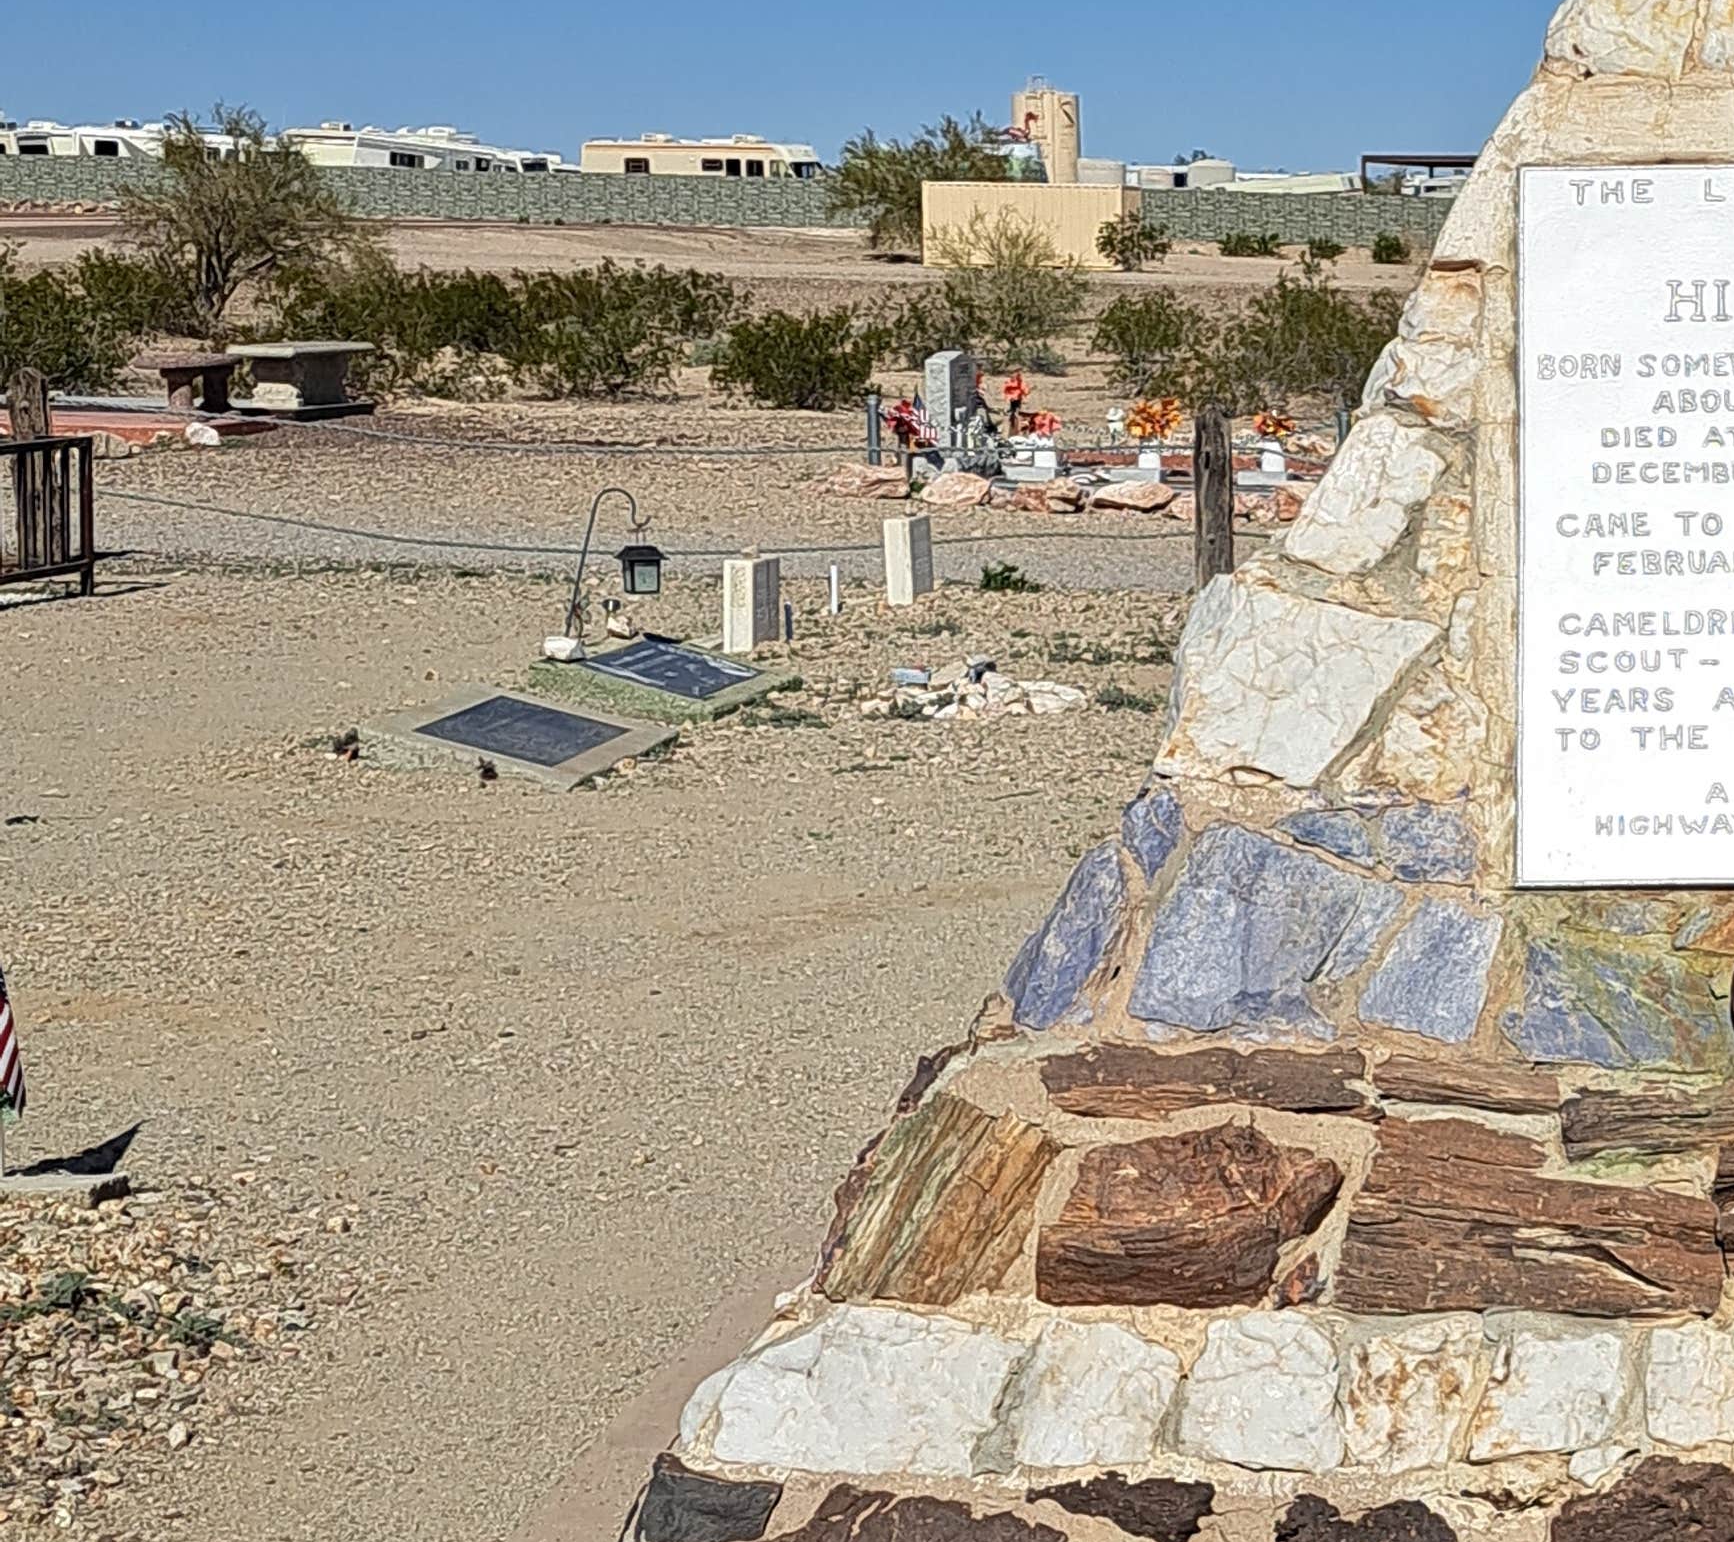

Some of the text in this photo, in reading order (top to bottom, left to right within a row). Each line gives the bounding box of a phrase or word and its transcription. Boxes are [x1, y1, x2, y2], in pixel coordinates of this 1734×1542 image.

[1569, 180, 1655, 206] THE
[1664, 279, 1732, 322] HI
[1537, 353, 1621, 379] BORN
[1601, 426, 1677, 448] DIED
[1556, 512, 1651, 537] CAME
[1674, 512, 1723, 536] TO
[1559, 648, 1688, 673] SCOUT
[1551, 687, 1675, 714] YEARS
[1555, 727, 1601, 751] TO
[1631, 725, 1708, 750] THE
